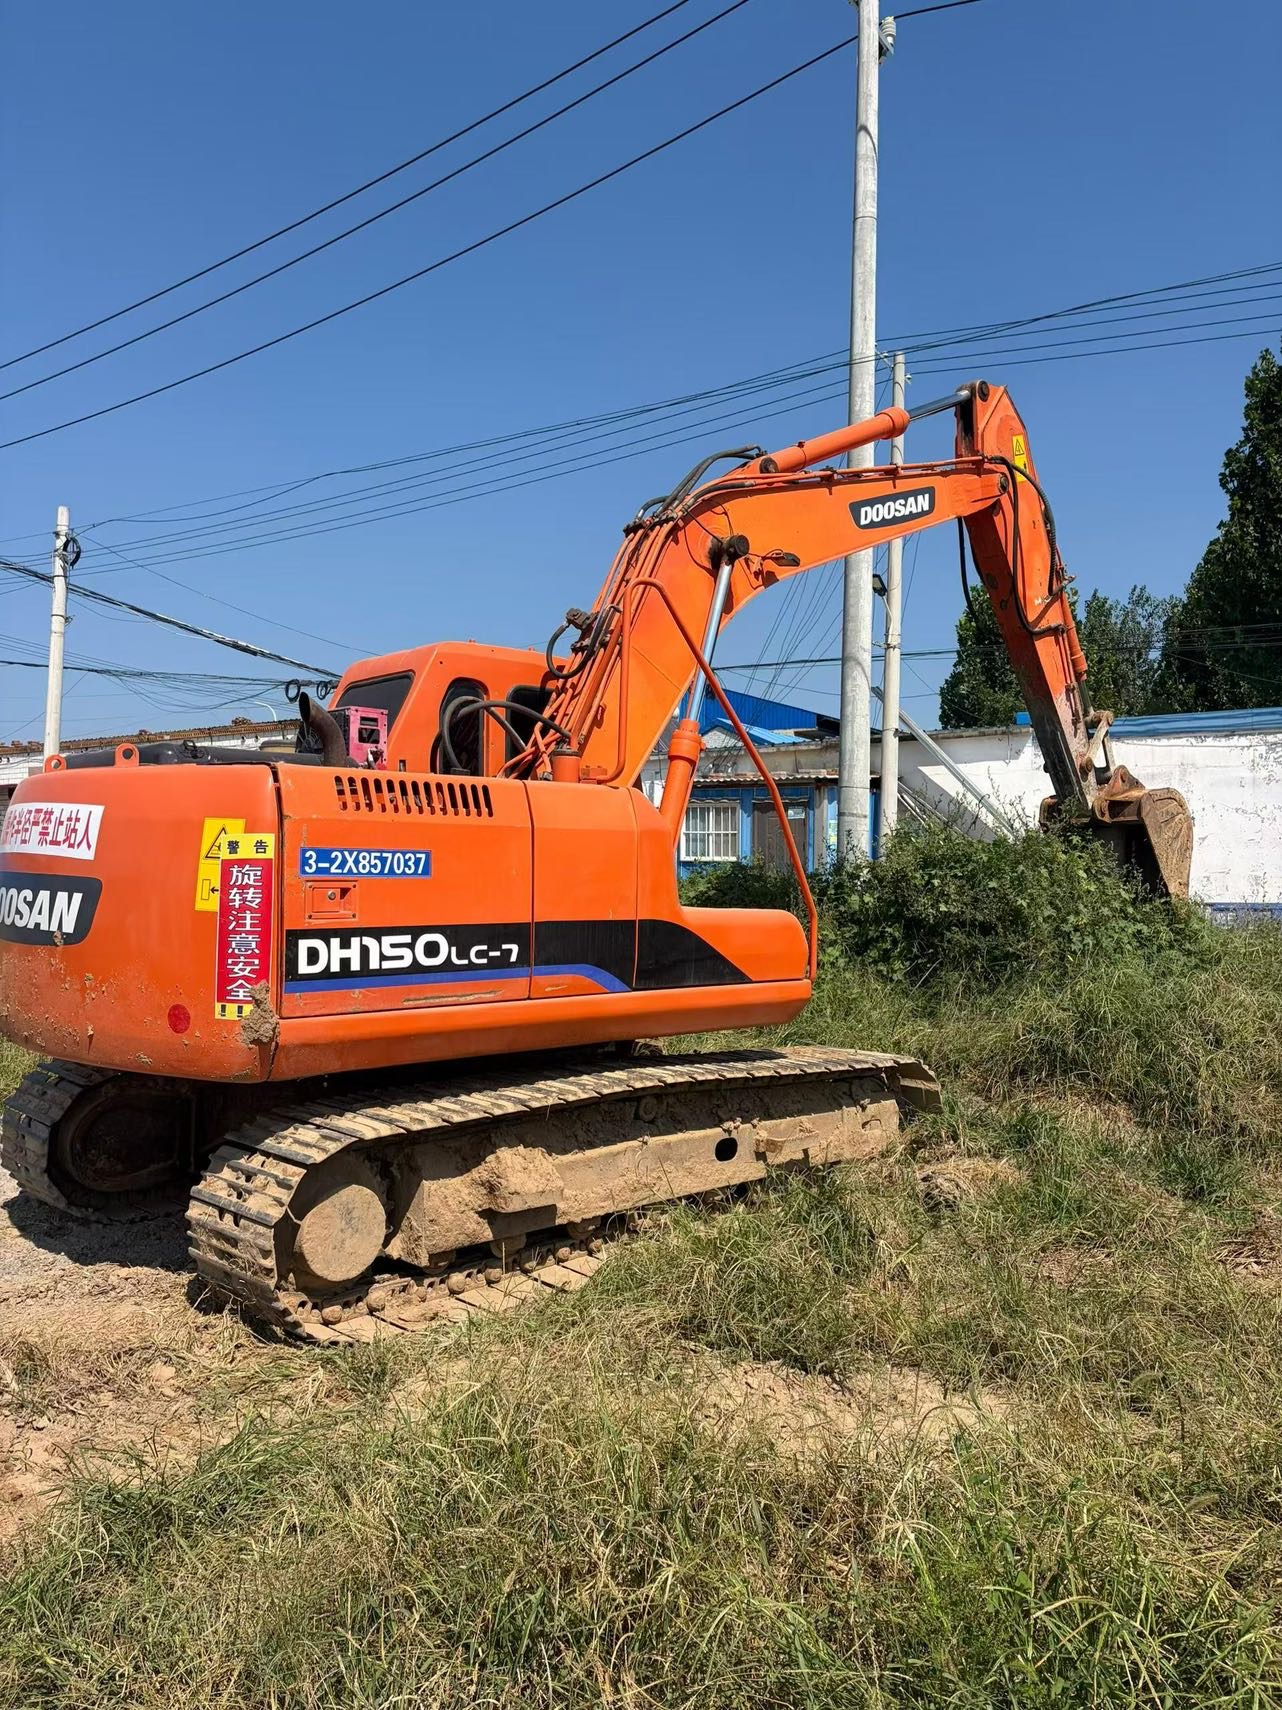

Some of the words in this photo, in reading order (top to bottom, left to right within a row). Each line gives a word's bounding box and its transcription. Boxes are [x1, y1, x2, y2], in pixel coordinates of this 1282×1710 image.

[860, 493, 930, 526] DOOSAN
[227, 839, 269, 855] 警告
[304, 850, 427, 874] 3-2X857037
[225, 864, 263, 1001] 旋转注意安全
